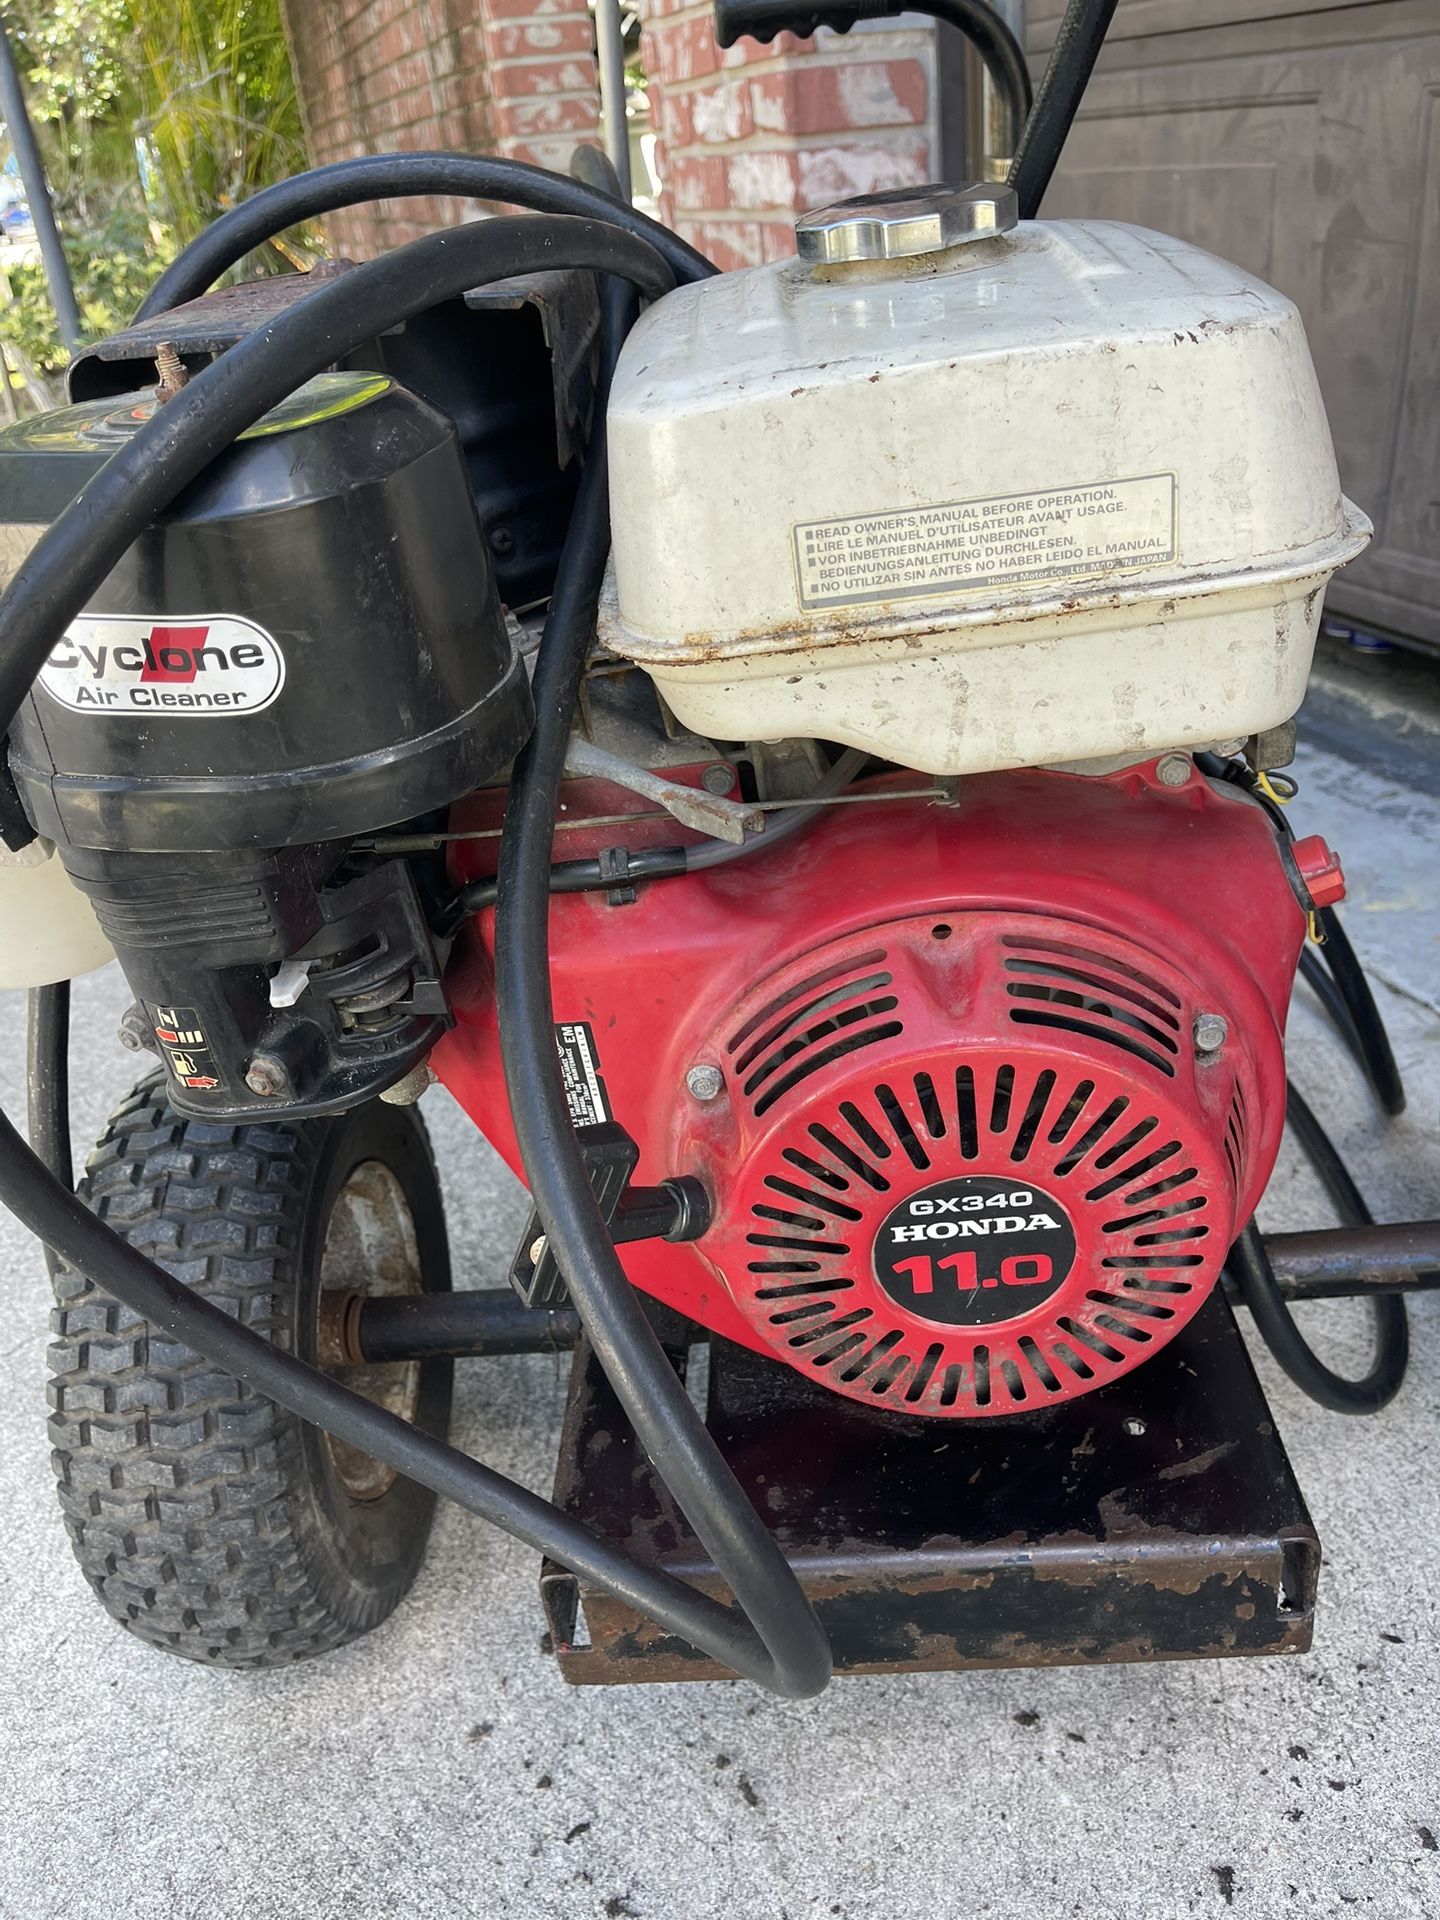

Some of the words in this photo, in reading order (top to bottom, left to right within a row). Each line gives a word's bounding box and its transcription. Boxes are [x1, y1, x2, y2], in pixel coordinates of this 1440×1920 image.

[815, 526, 850, 539] READ
[855, 517, 915, 534] OWNER'S
[920, 507, 979, 524] MANUAL
[983, 500, 1033, 516] BEFORE
[1038, 489, 1117, 508] OPERATION.
[817, 540, 844, 552] LIRE
[848, 538, 862, 549] LE
[867, 530, 923, 546] MANUEL
[927, 514, 1024, 537] D'UTILISATEUR
[1029, 508, 1073, 522] AVANT
[1078, 502, 1127, 517] USAGE.
[818, 554, 846, 565] VOR
[850, 536, 965, 562] INBETRIEBNAHME
[970, 526, 1048, 545] UNBEDINGT
[820, 549, 980, 579] BEDIENUNGSANLEITUNG
[985, 536, 1077, 557] DURCHLESEN.
[821, 580, 840, 592] NO
[844, 573, 900, 589] UTILIZAR
[904, 570, 926, 581] SIN
[929, 563, 972, 577] ANTES
[976, 560, 995, 572] NO
[1000, 554, 1042, 568] HABER
[1046, 549, 1083, 562] LEIDO
[1087, 546, 1102, 556] EL
[1105, 538, 1166, 554] MANUAL.
[988, 576, 1018, 585] Honda
[1020, 571, 1048, 581] Motor
[1135, 553, 1167, 566] JAPAN
[47, 635, 265, 678] Cyclone
[76, 687, 118, 705] Air
[130, 688, 247, 706] Cleaner
[909, 1191, 1033, 1216] GX340
[890, 1214, 1061, 1243] HONDA
[892, 1251, 1053, 1294] 11.0
